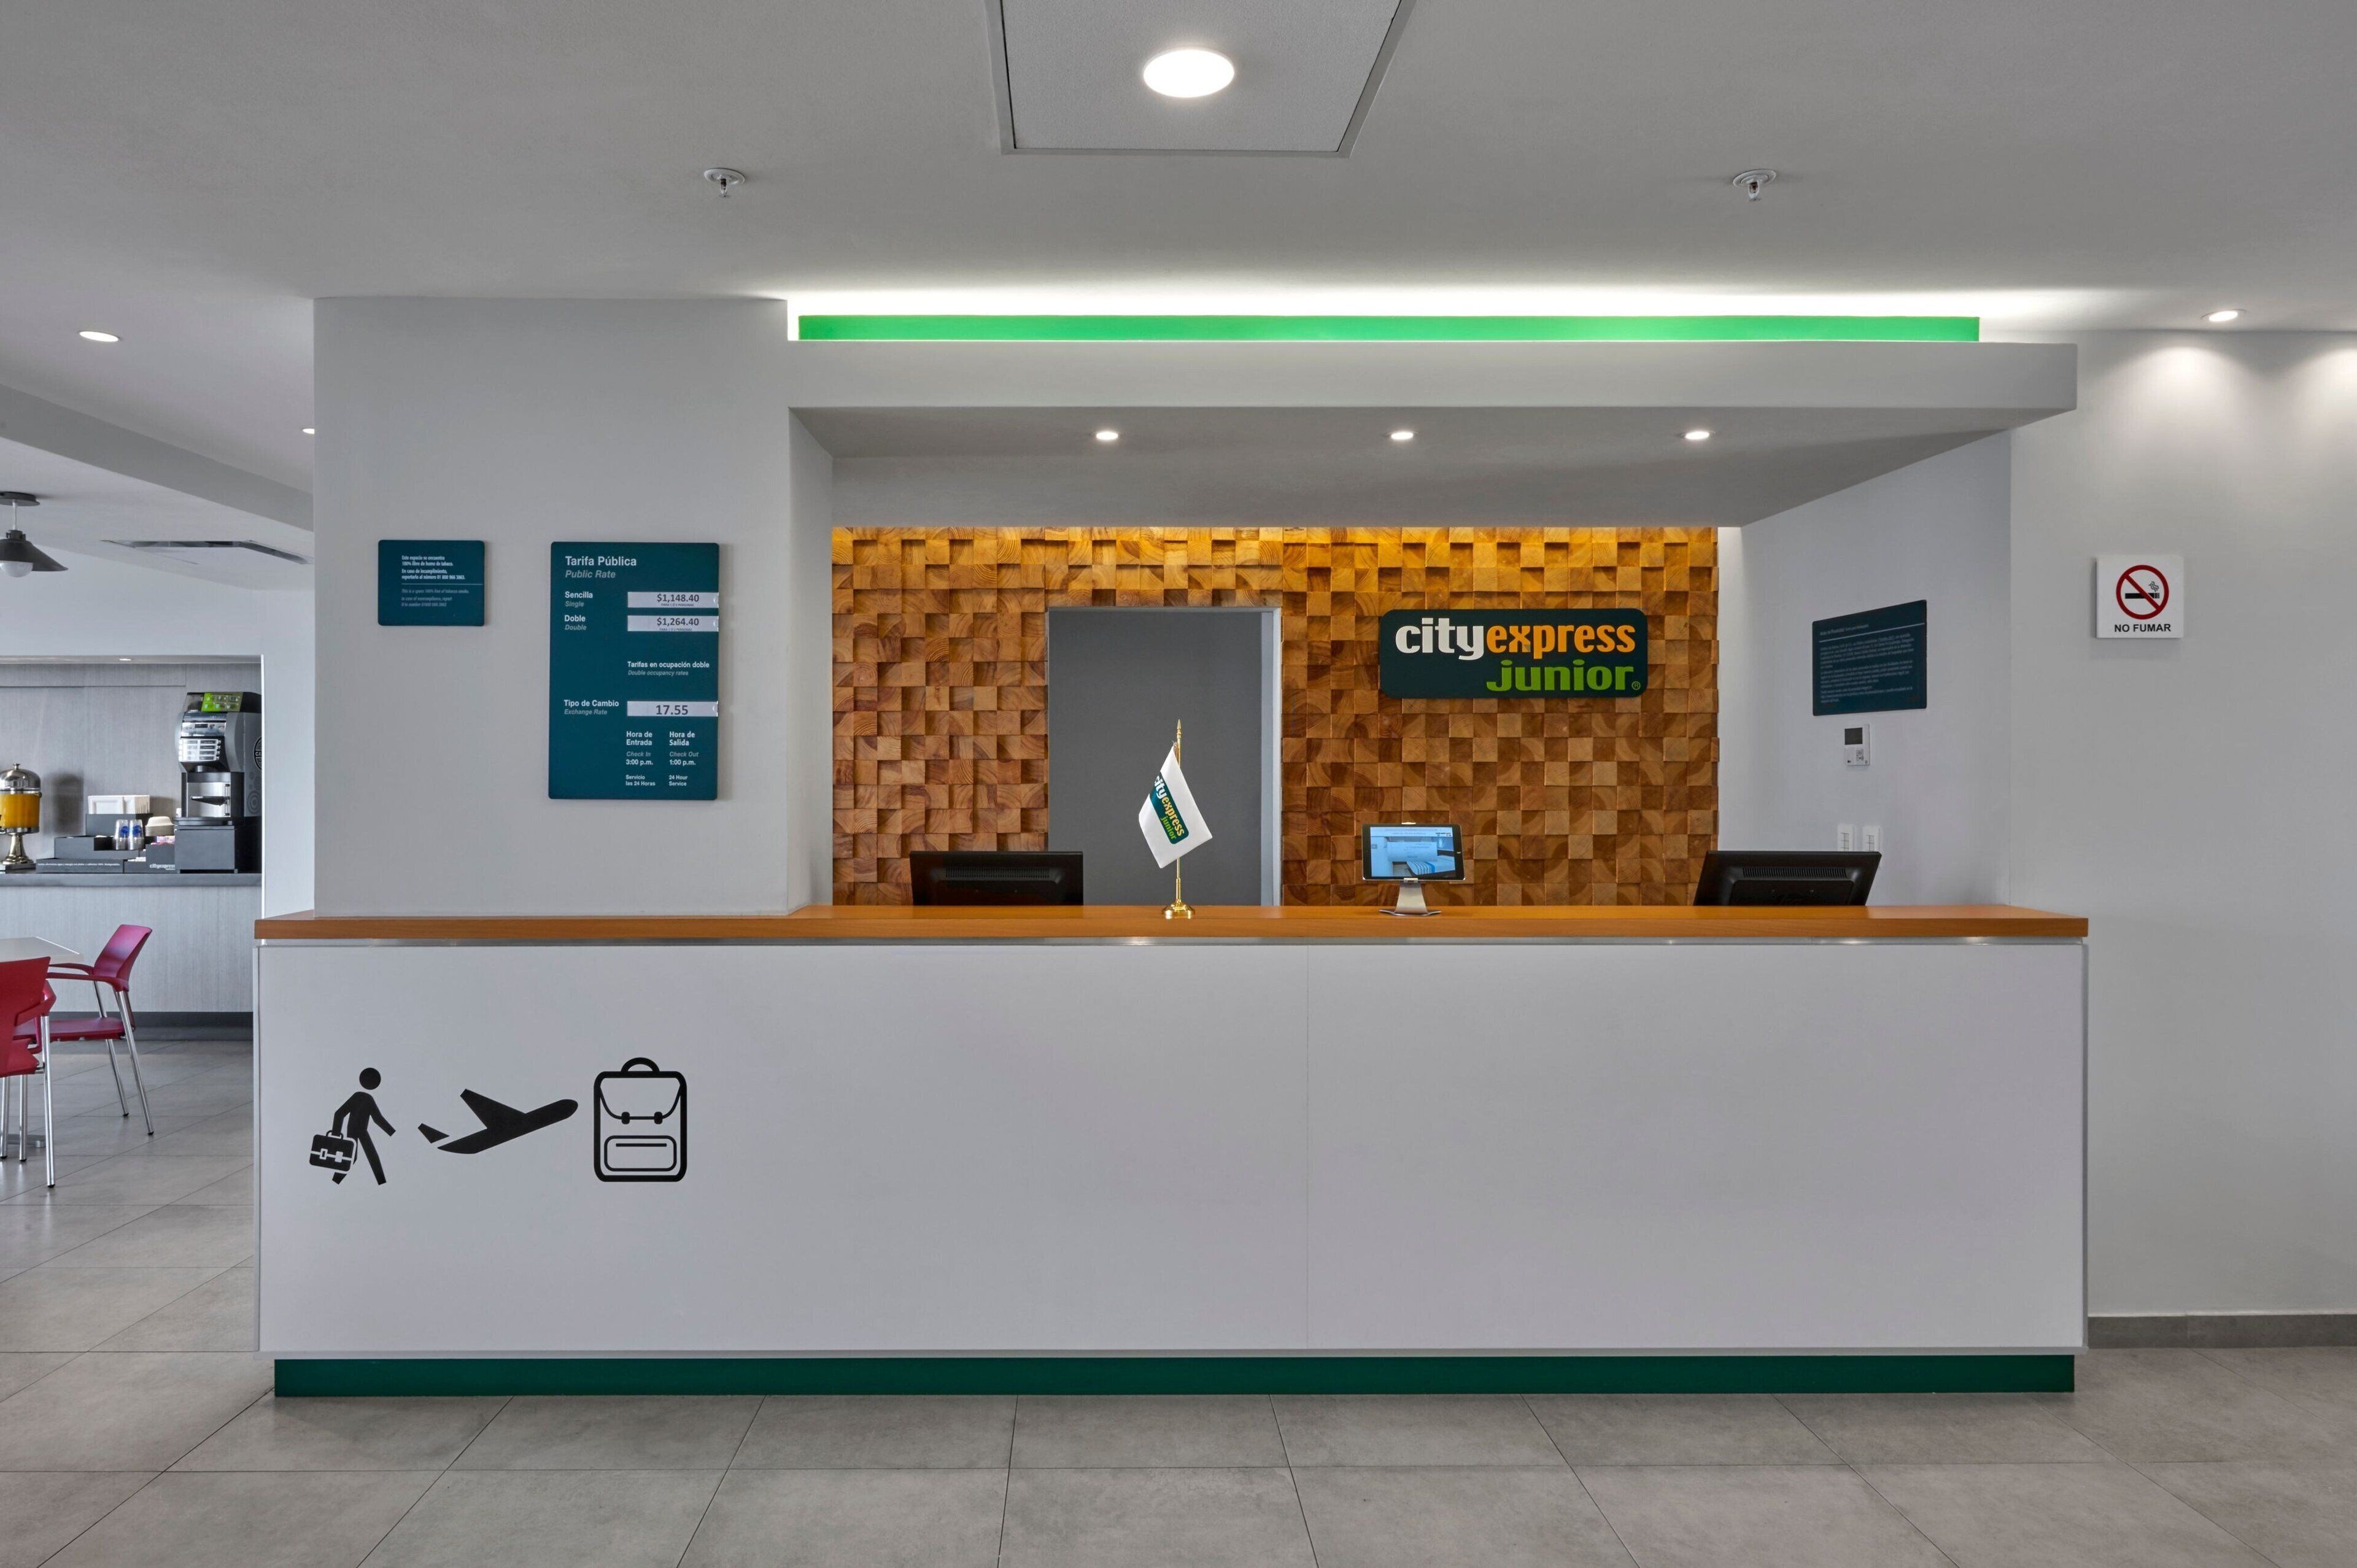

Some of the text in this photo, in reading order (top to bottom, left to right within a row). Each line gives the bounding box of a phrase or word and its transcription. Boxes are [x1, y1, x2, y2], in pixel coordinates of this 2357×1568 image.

[565, 556, 637, 566] Tarifa Pública
[657, 593, 699, 603] $1,148.40
[657, 617, 699, 627] $1,264.40
[2133, 624, 2171, 632] FUMAR
[1395, 617, 1635, 660] cityexpress
[656, 705, 689, 715] 17.55
[1161, 815, 1176, 839] junior
